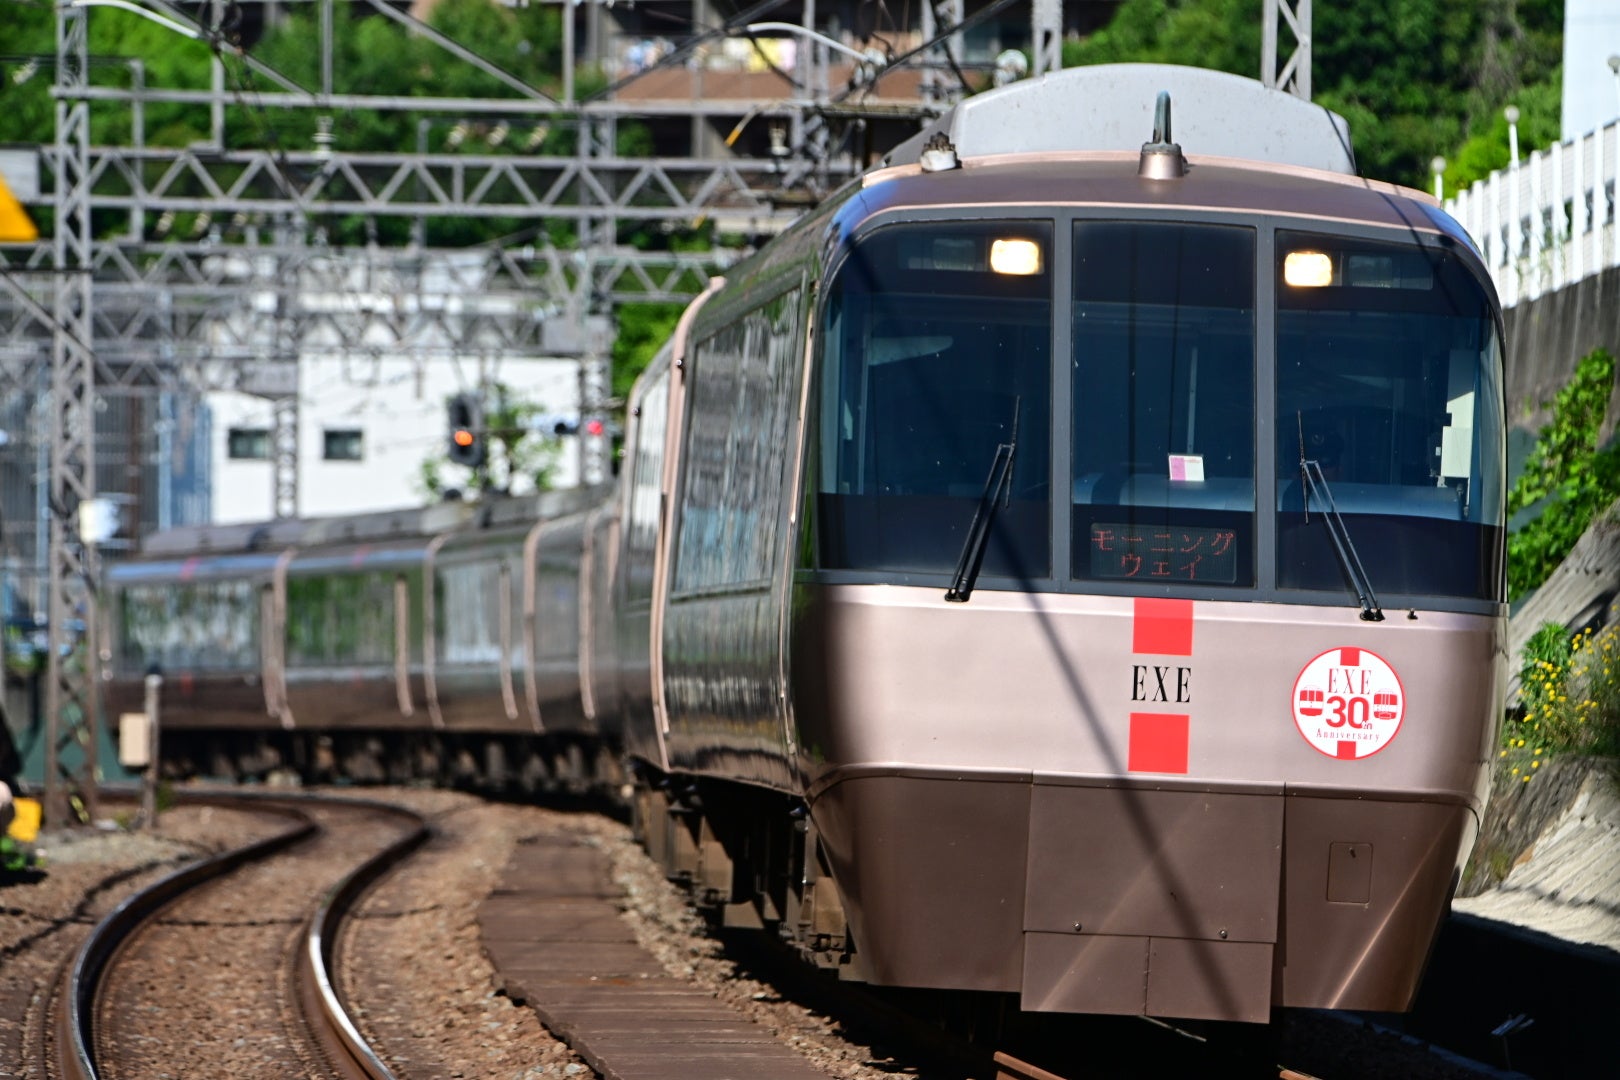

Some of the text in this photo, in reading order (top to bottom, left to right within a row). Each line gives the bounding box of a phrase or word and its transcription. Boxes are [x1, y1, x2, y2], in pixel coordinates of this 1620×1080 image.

[1091, 529, 1234, 556] モーニング
[1120, 553, 1203, 580] ウェイ
[1131, 665, 1191, 703] EXE
[1328, 668, 1372, 695] EXE
[1316, 728, 1380, 742] Anniversary
